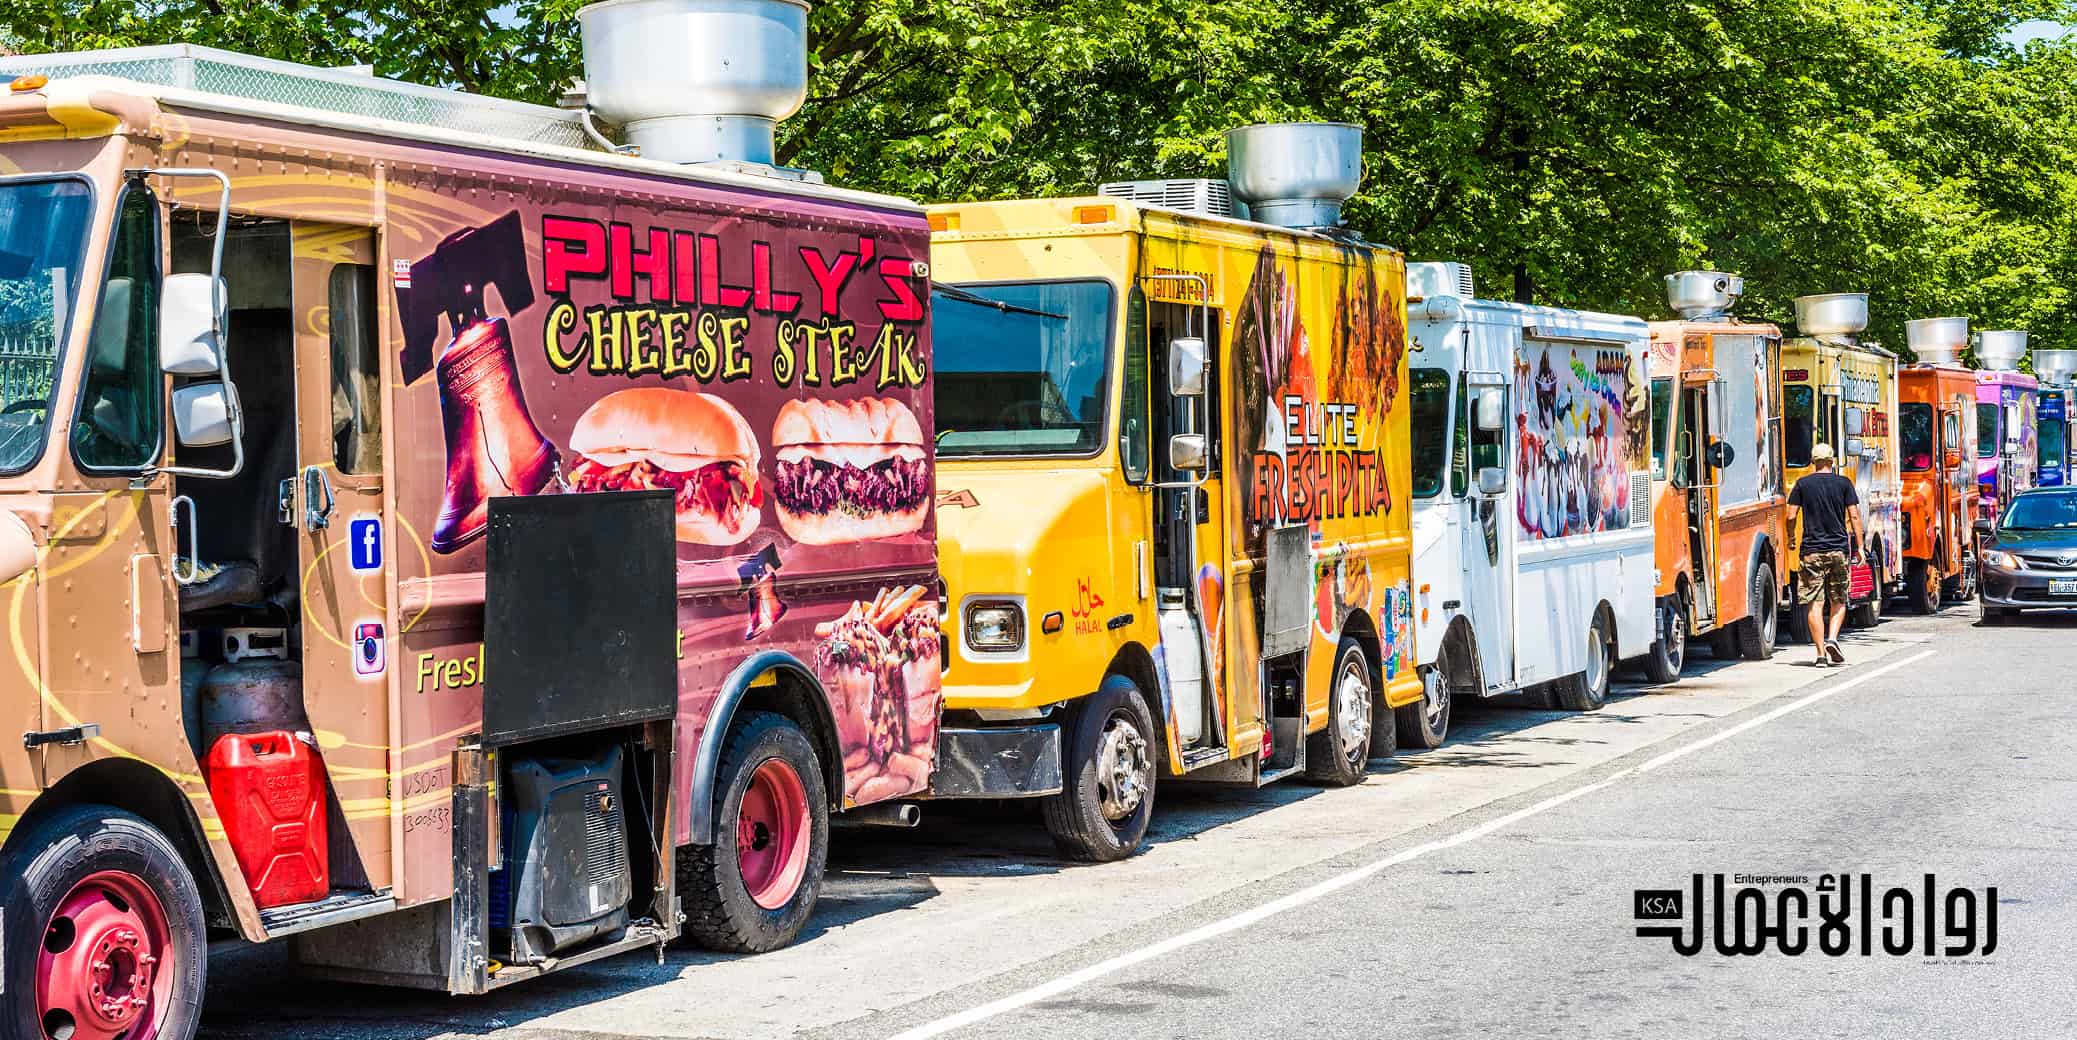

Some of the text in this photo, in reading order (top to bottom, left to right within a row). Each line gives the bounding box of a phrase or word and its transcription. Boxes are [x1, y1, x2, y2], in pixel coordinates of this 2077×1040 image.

[541, 214, 926, 321] PHILLY'S
[545, 304, 752, 379] CHEESE
[772, 317, 926, 391] STEAK
[1284, 394, 1358, 448] ELITE
[1253, 447, 1391, 530] FRESH PITA
[1072, 576, 1104, 618] حلال
[1075, 620, 1103, 637] HALAL
